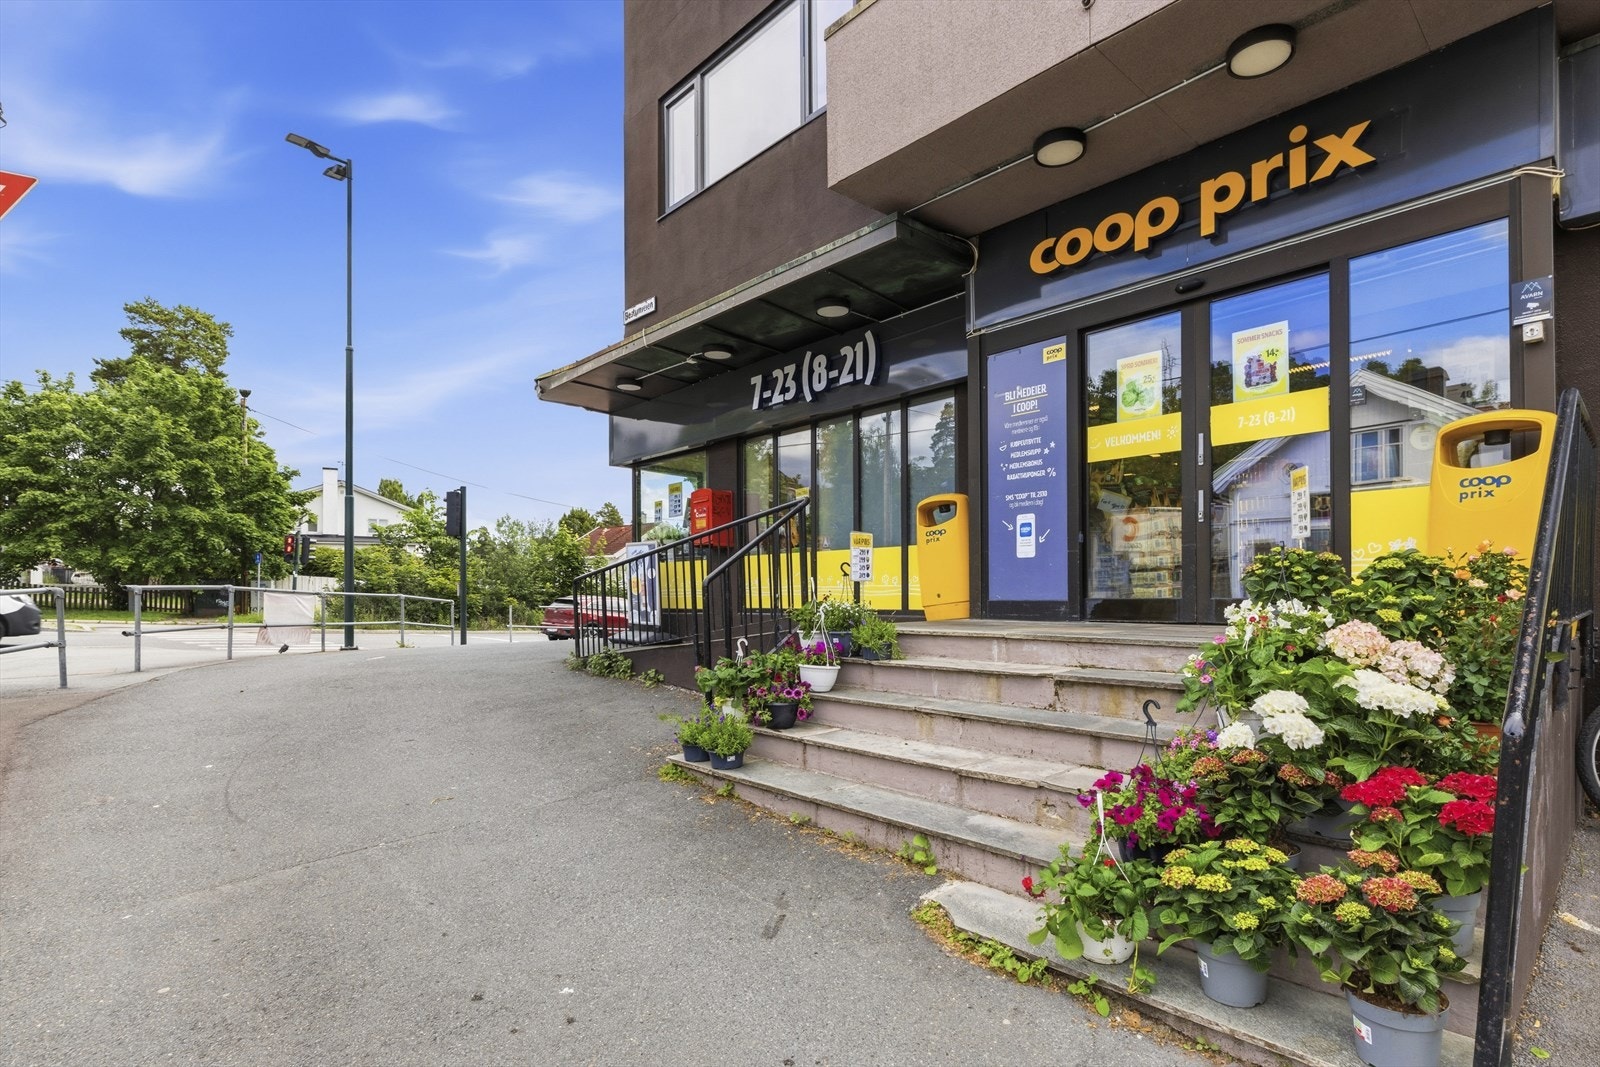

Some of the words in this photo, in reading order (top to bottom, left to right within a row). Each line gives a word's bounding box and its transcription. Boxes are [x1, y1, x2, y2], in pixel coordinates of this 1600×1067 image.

[1030, 197, 1180, 275] coop
[1201, 120, 1377, 237] prix
[1520, 291, 1543, 300] AVARN
[1237, 333, 1261, 344] SOMMER
[1262, 329, 1283, 339] SNACKS
[1046, 347, 1062, 355] coop
[751, 363, 796, 410] 7-23
[802, 330, 876, 402] (8-21)
[1005, 390, 1015, 401] BLI
[1017, 384, 1047, 397] MEDEIER
[1017, 400, 1038, 412] COOP!
[1238, 413, 1261, 428] 7-23
[1263, 407, 1296, 426] (8-21)
[1105, 430, 1161, 448] VELKOMMEN!
[1459, 475, 1512, 488] coop
[1459, 487, 1495, 503] prix
[926, 528, 946, 536] coop
[926, 536, 940, 545] prix
